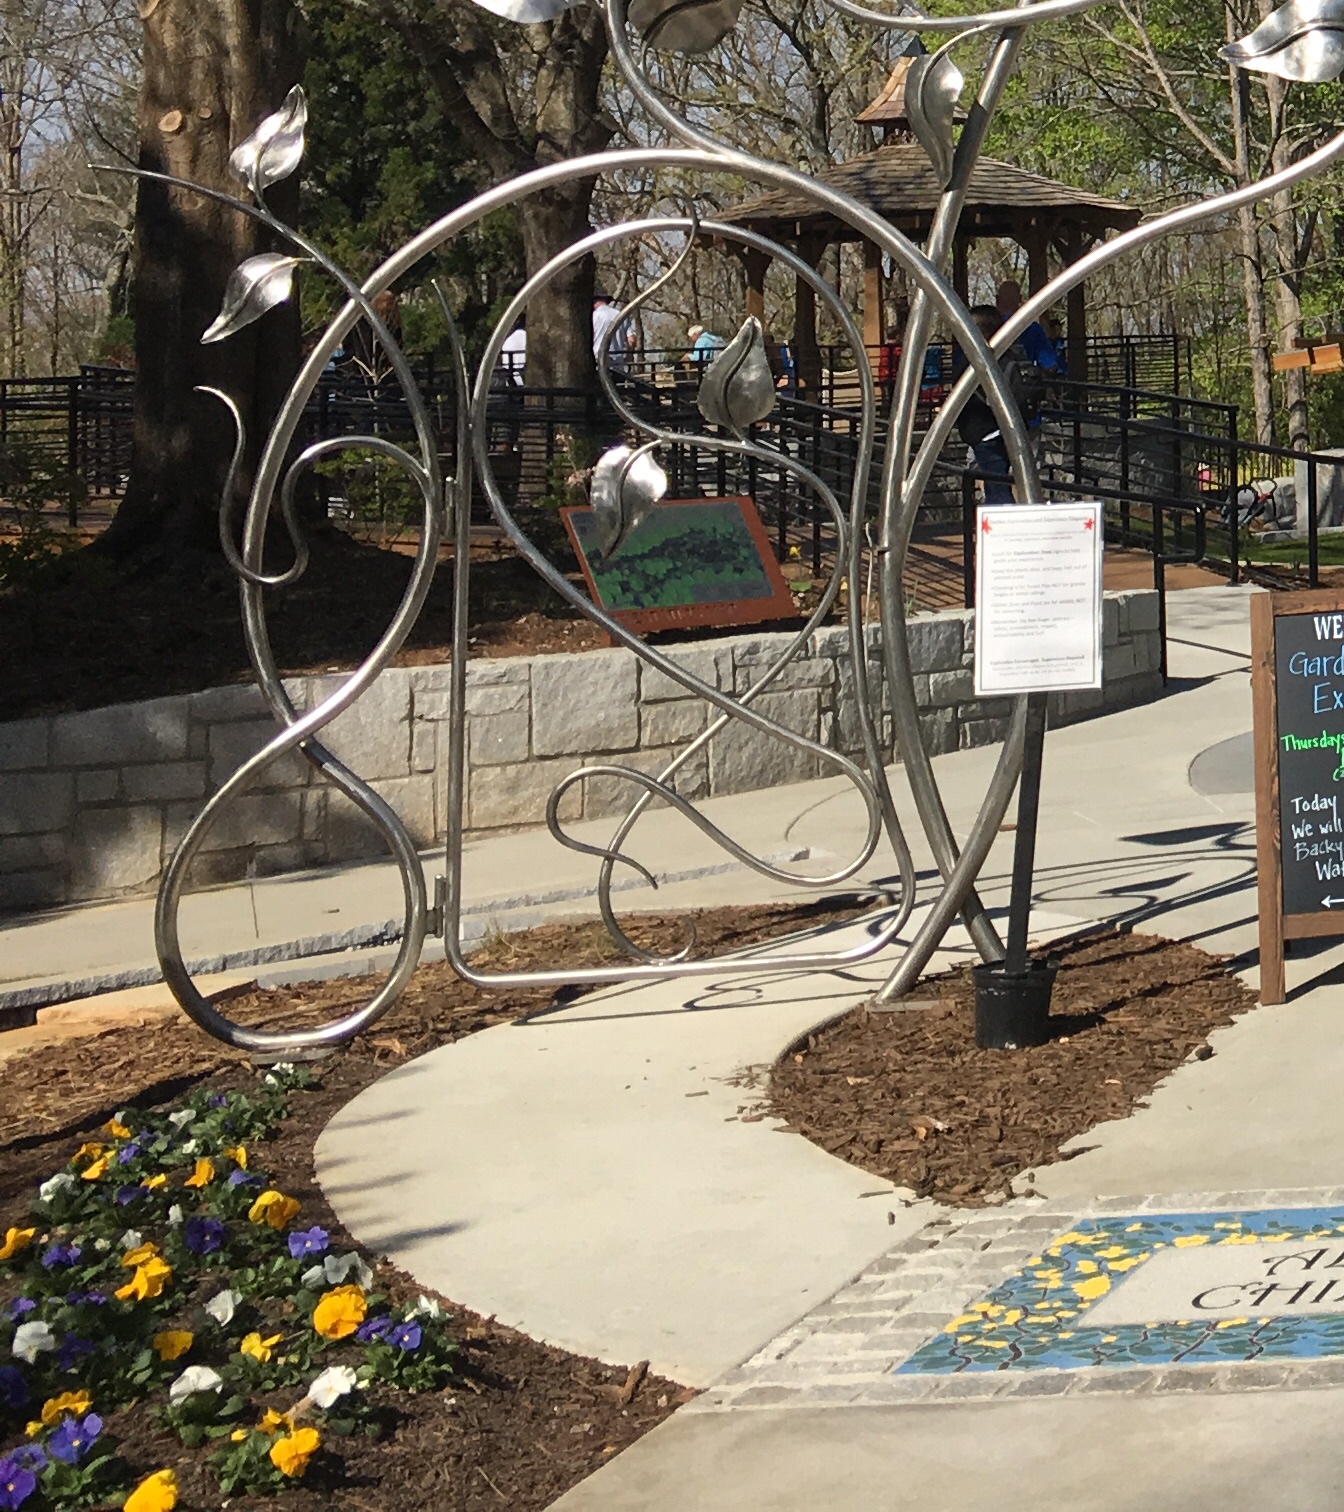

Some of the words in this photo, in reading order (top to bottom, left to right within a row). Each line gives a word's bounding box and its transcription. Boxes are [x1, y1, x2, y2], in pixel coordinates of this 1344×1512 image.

[1290, 793, 1337, 816] Today
[1291, 818, 1314, 839] We
[1319, 816, 1343, 833] will
